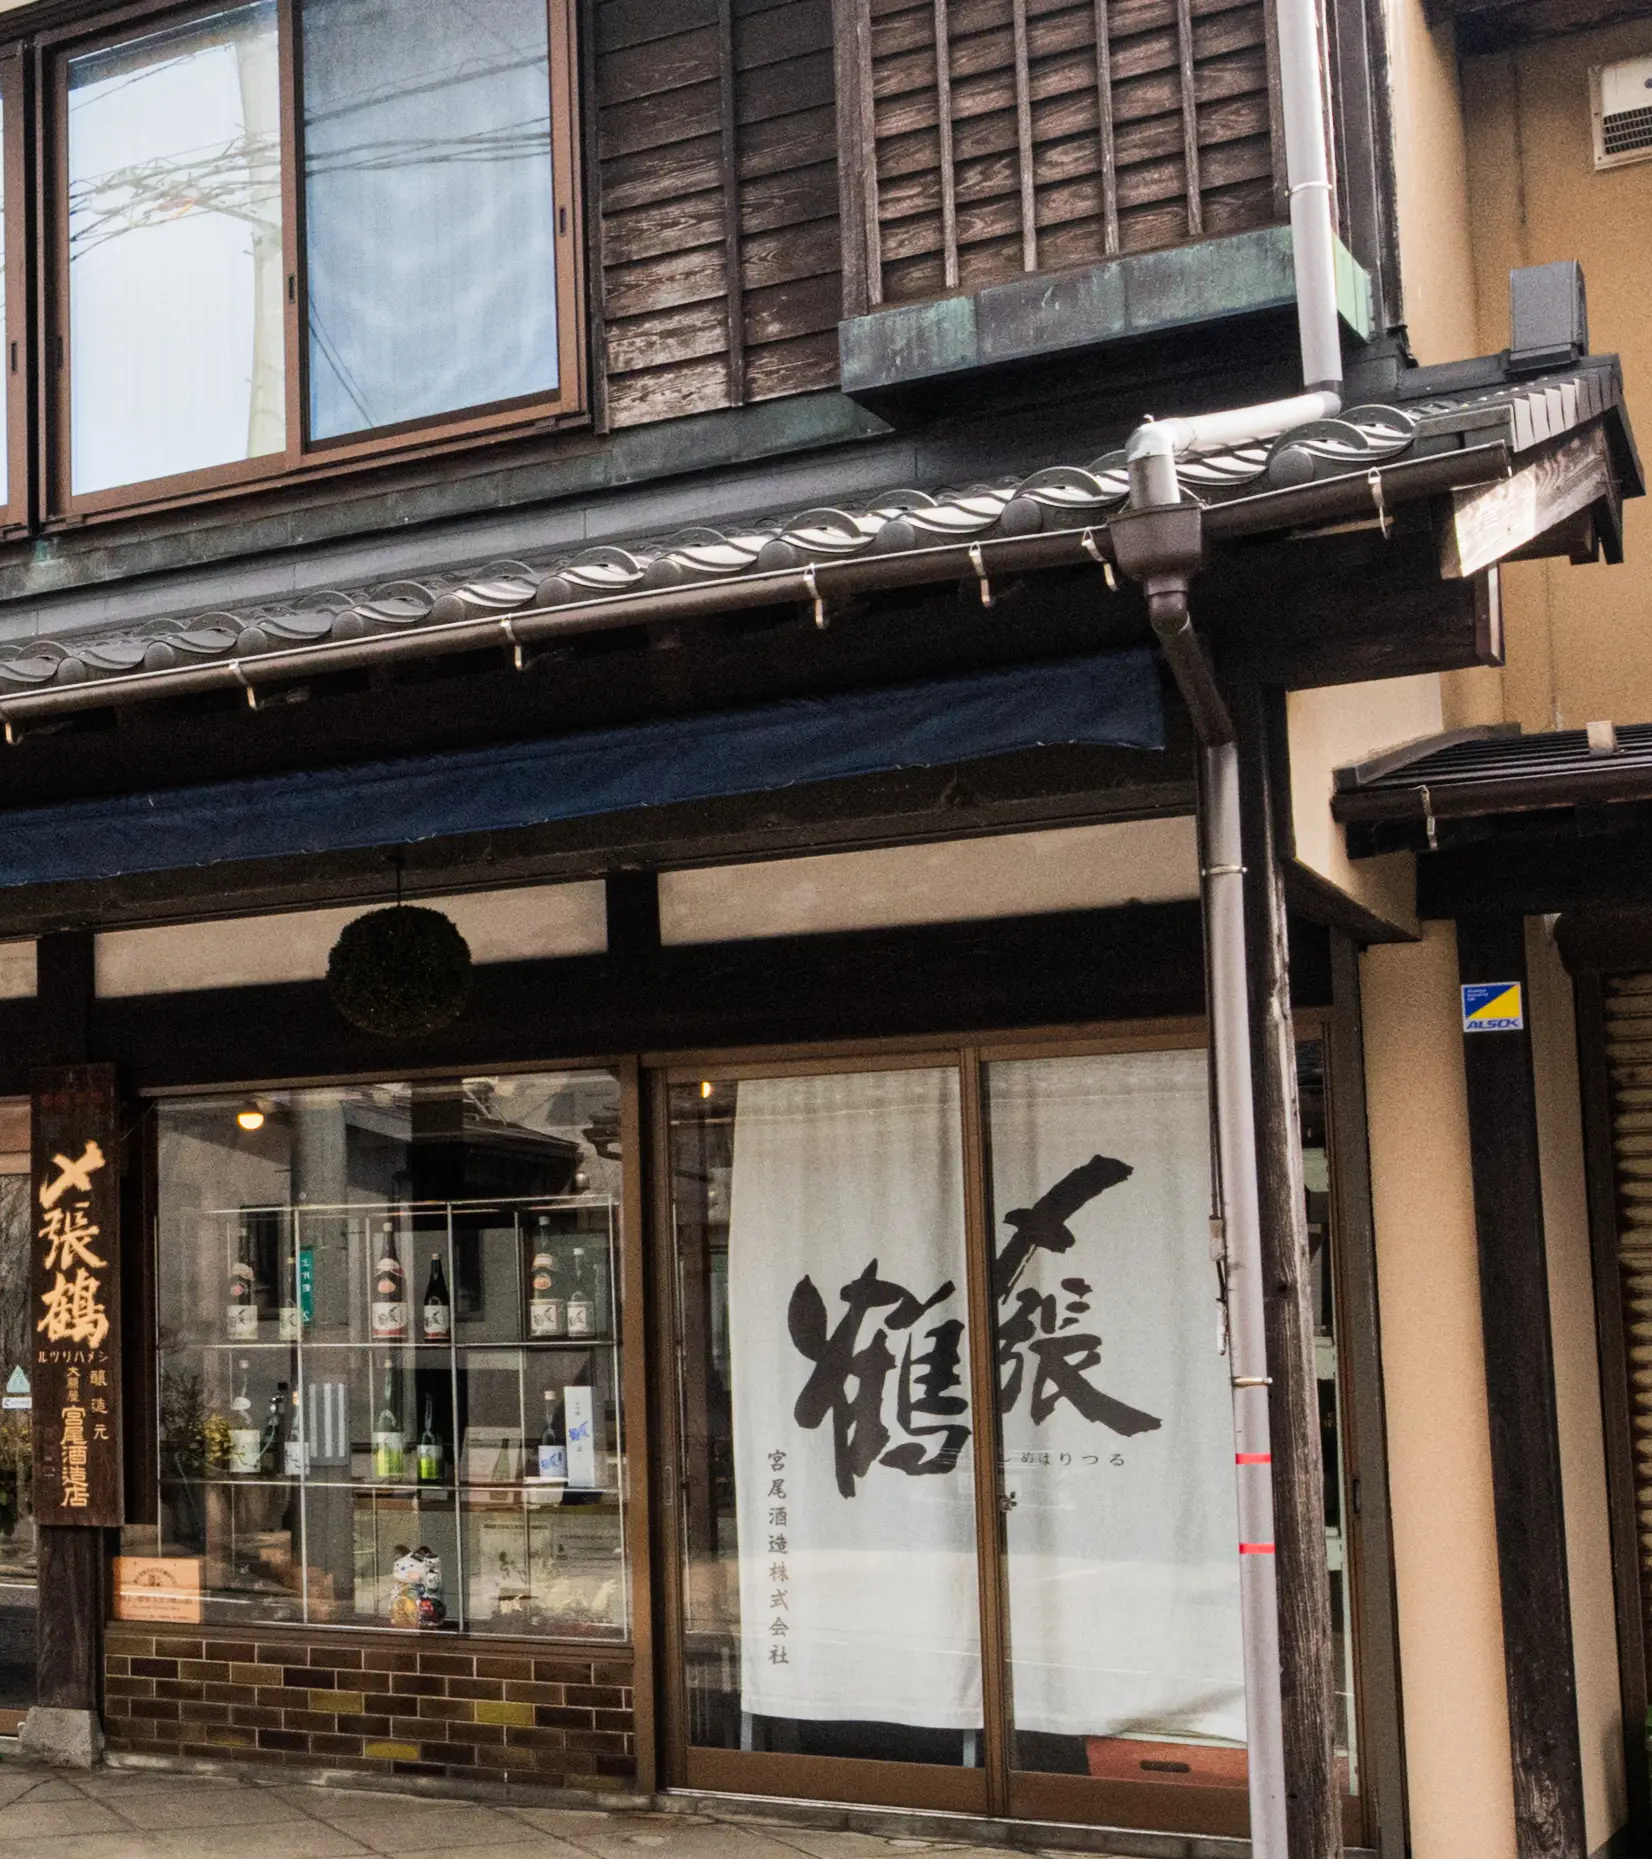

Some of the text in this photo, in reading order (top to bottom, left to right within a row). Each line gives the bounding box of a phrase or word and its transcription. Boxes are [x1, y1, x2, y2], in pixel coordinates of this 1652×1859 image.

[1466, 1018, 1520, 1029] ALSOK
[60, 1405, 90, 1507] 宮尾酒造店
[768, 1449, 790, 1665] 宮尾酒造株式会社
